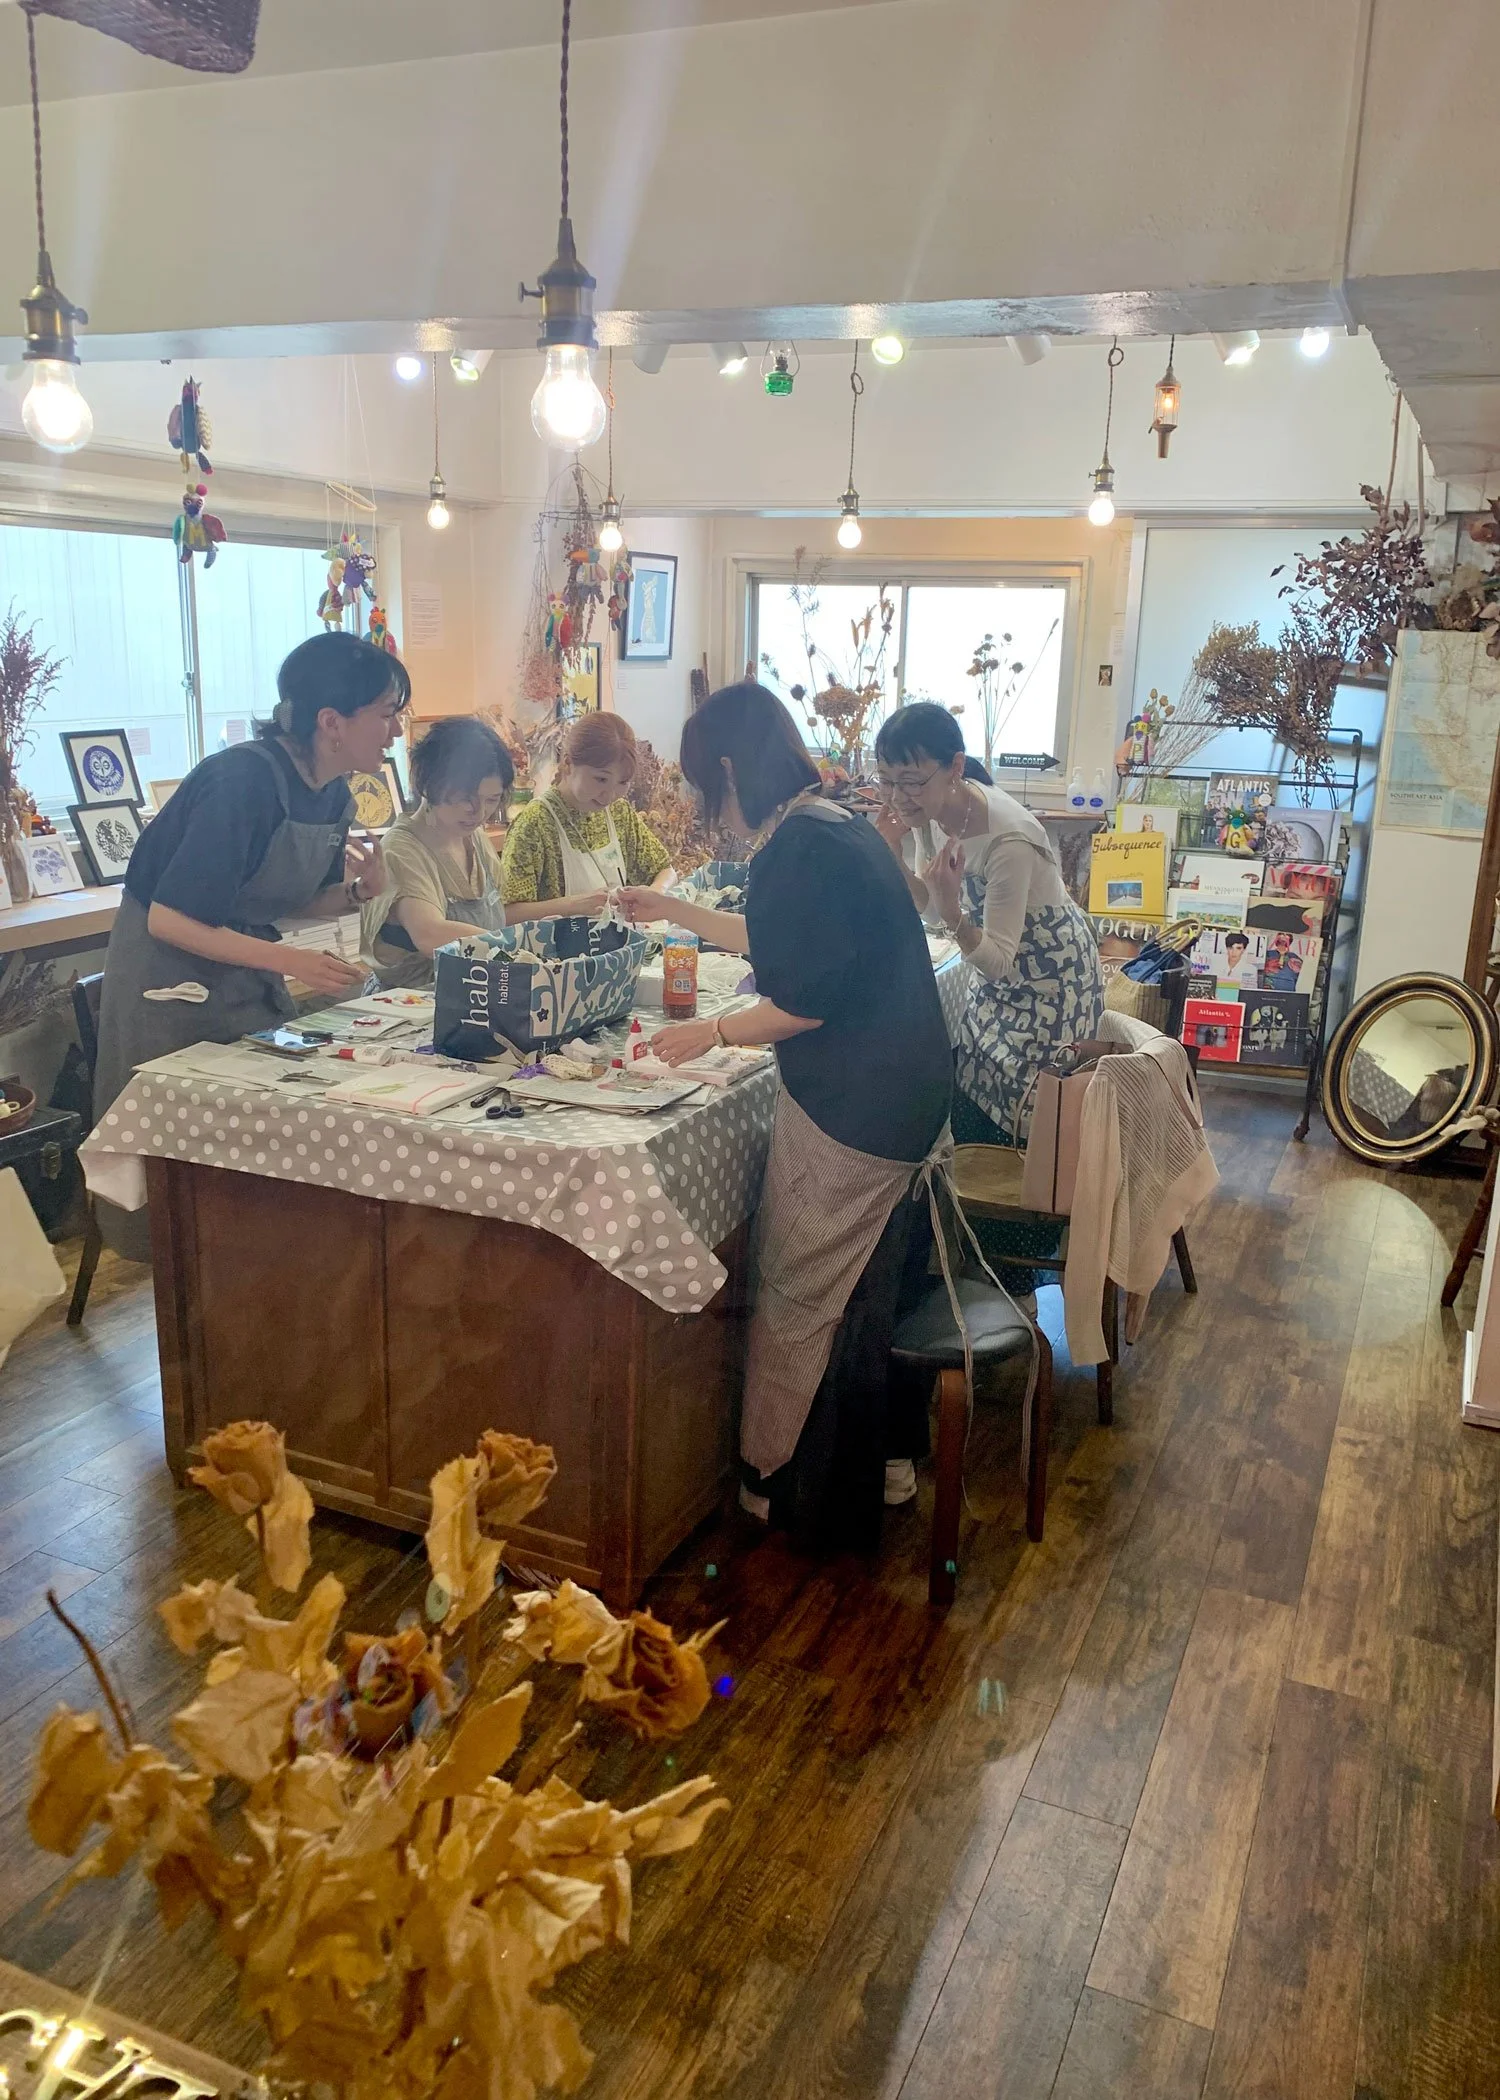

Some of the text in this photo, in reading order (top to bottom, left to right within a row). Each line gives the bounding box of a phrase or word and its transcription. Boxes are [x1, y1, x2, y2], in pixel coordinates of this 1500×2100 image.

[1003, 755, 1046, 766] WELCOME
[1216, 778, 1272, 794] ATLANTIS
[1092, 836, 1162, 860] Subsequence
[1229, 831, 1242, 849] G
[1190, 931, 1265, 958] ELE
[1198, 1009, 1225, 1017] Atlantis
